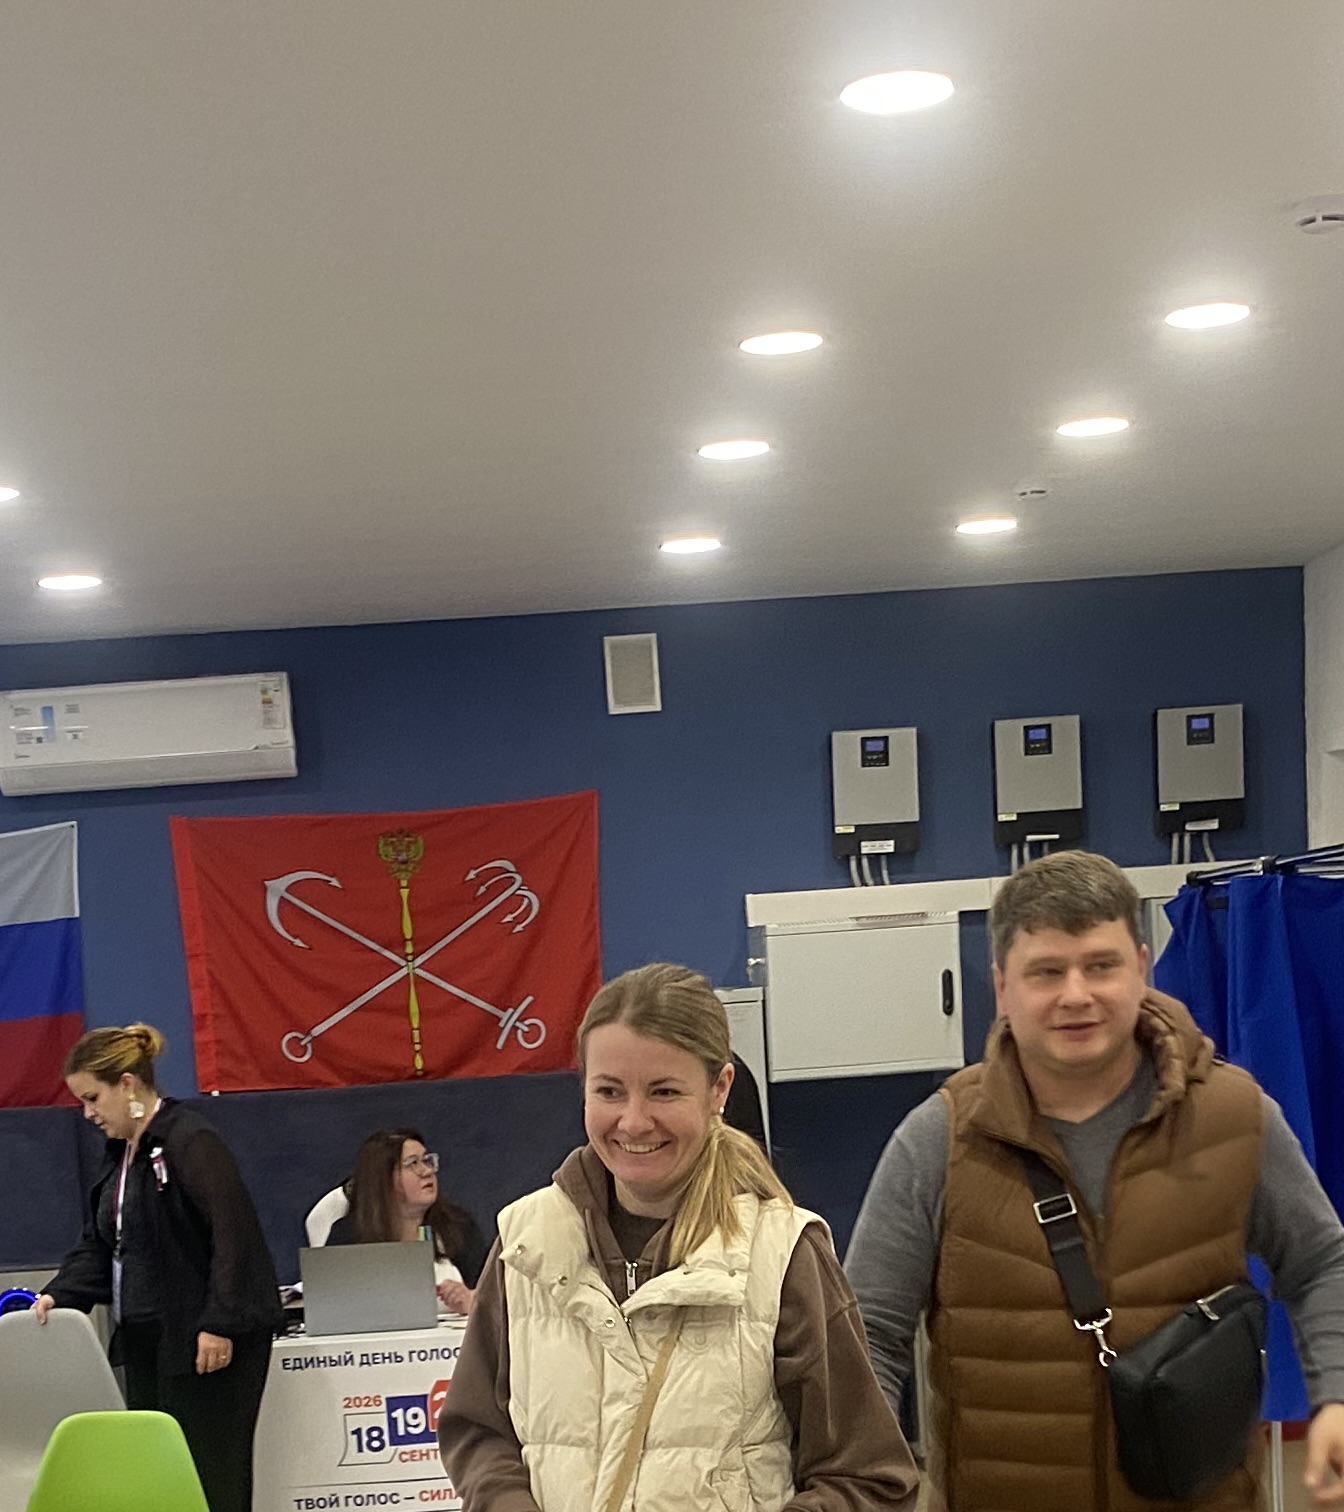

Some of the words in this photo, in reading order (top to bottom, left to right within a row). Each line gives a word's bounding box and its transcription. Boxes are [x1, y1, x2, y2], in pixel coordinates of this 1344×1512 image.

[282, 1351, 354, 1371] ЕДИНЫЙ
[359, 1353, 404, 1367] ДЕНЬ
[343, 1395, 383, 1408] 2026
[351, 1426, 385, 1453] 18
[391, 1406, 426, 1436] 19
[294, 1494, 340, 1510] ТВОЙ
[345, 1492, 400, 1506] ГОЛОС
[418, 1488, 457, 1502] СИЛ
